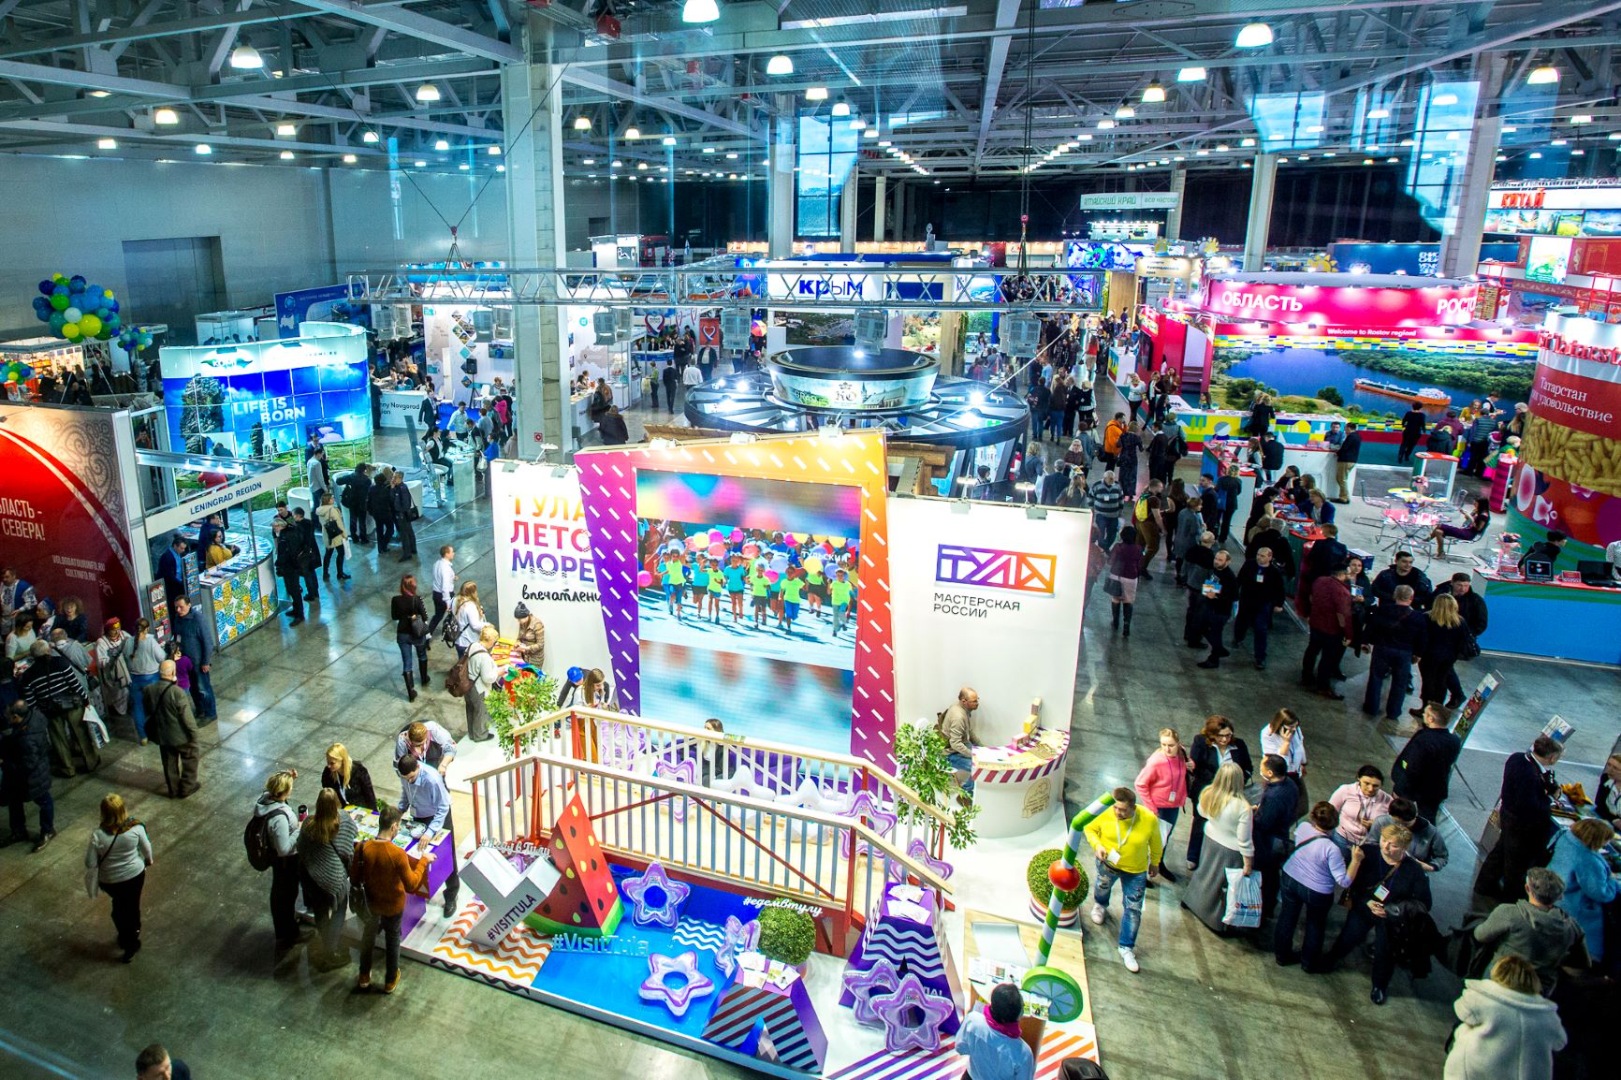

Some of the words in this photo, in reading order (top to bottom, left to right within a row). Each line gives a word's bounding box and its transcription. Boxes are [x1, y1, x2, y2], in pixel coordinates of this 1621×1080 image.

[1221, 291, 1304, 313] ОБЛАСТЬ
[1327, 328, 1358, 336] Welcome
[1367, 328, 1390, 336] Rostov
[1541, 377, 1588, 402] Татарстан
[233, 399, 269, 415] LIFE
[272, 397, 288, 409] IS
[260, 406, 306, 424] BORN
[1537, 392, 1613, 423] удовольствие
[190, 492, 234, 515] LENINGRAD
[235, 481, 262, 498] REGION
[2, 518, 46, 541] СЕВЕРА!
[510, 520, 592, 553] ЛЕТО
[511, 548, 595, 583] МОРЕ
[933, 603, 988, 618] РОССИИ
[934, 592, 1021, 612] МАСТЕРСКАЯ
[486, 893, 538, 942] #VISITTULA
